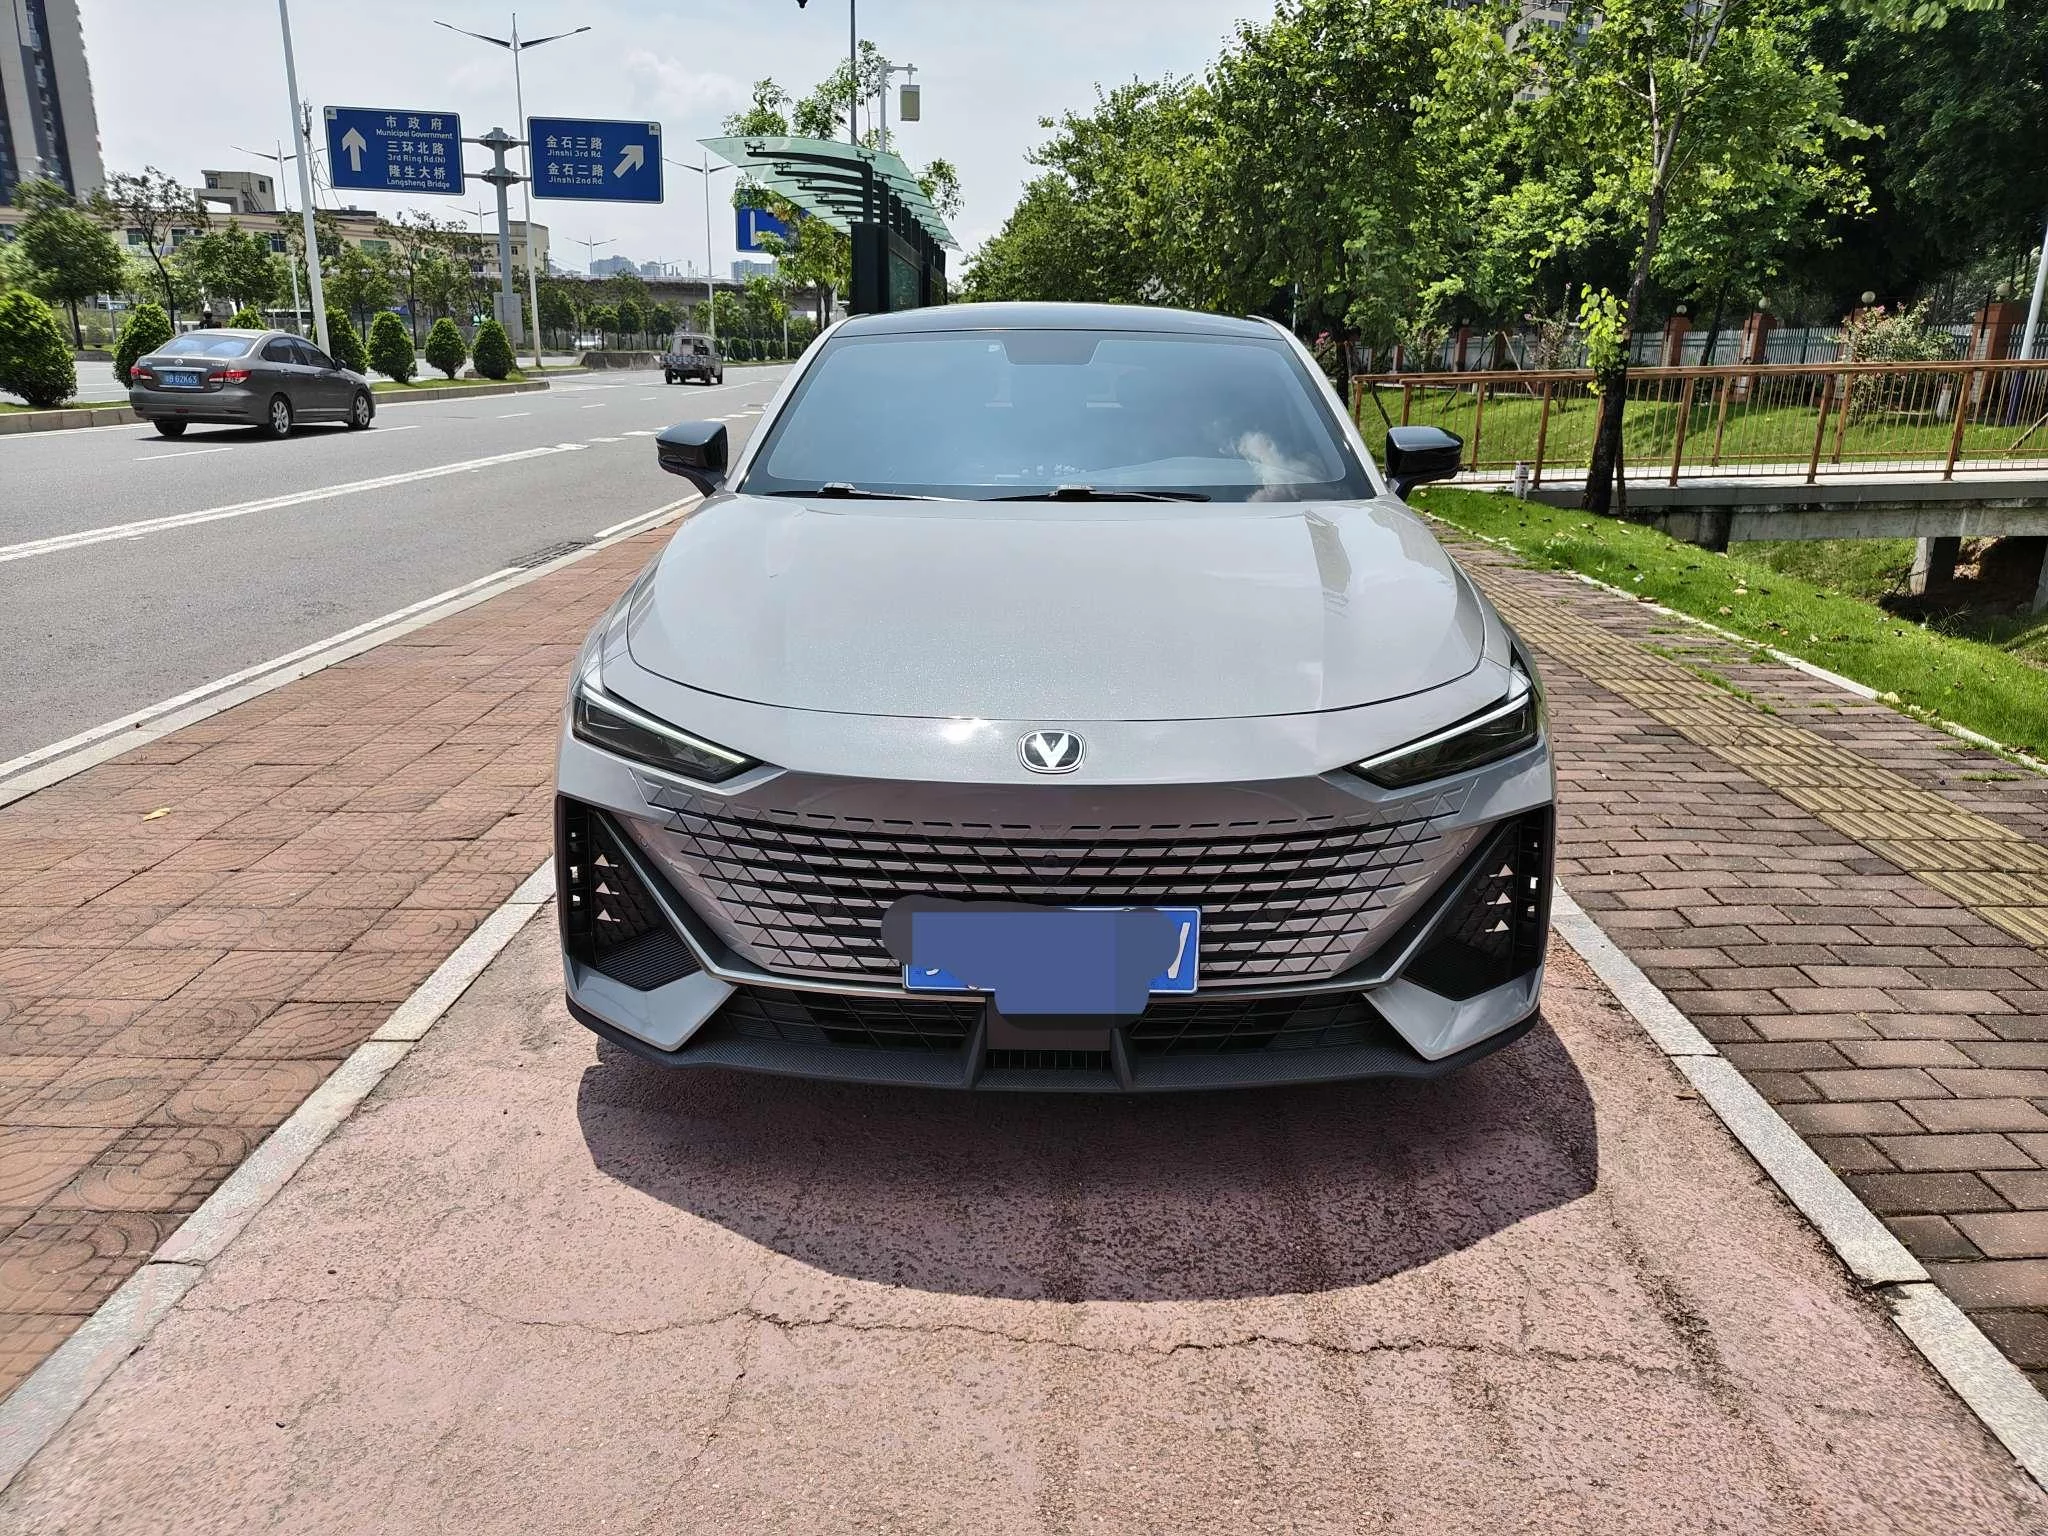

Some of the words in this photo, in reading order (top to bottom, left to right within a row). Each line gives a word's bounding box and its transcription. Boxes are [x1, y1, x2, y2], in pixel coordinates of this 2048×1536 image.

[385, 115, 442, 130] 市政府
[376, 128, 410, 138] Municipal
[411, 130, 453, 139] Government
[387, 140, 444, 156] 三环北路
[545, 135, 602, 149] 金石三路
[403, 155, 422, 164] Ring
[388, 164, 446, 180] 隆生大桥
[547, 162, 604, 177] 金石二路
[426, 180, 450, 189] Bridge
